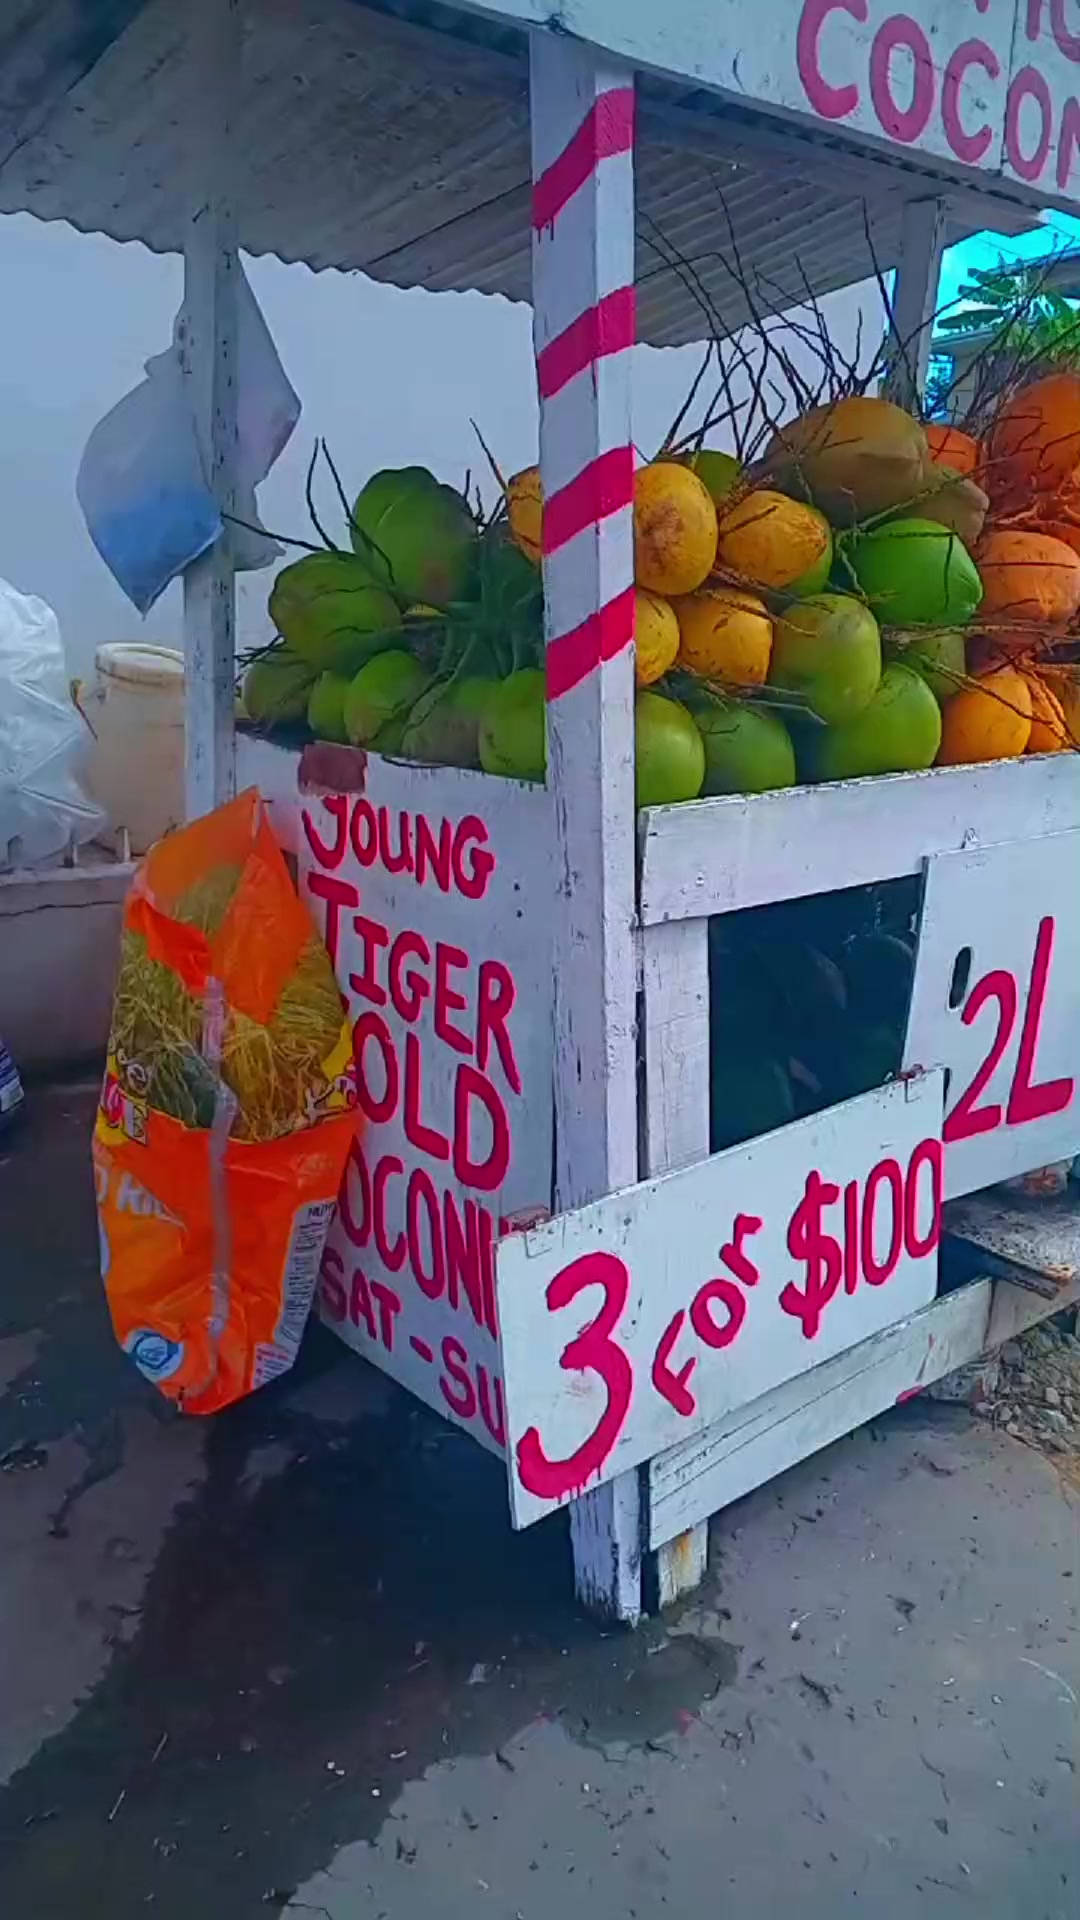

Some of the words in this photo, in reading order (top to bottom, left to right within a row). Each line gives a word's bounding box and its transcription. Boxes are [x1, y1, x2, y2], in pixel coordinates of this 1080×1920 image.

[307, 871, 521, 1095] TIGER
[942, 915, 1074, 1144] 2L
[352, 1011, 510, 1191] OLD
[516, 1251, 633, 1500] 3
[778, 1137, 944, 1340] $100
